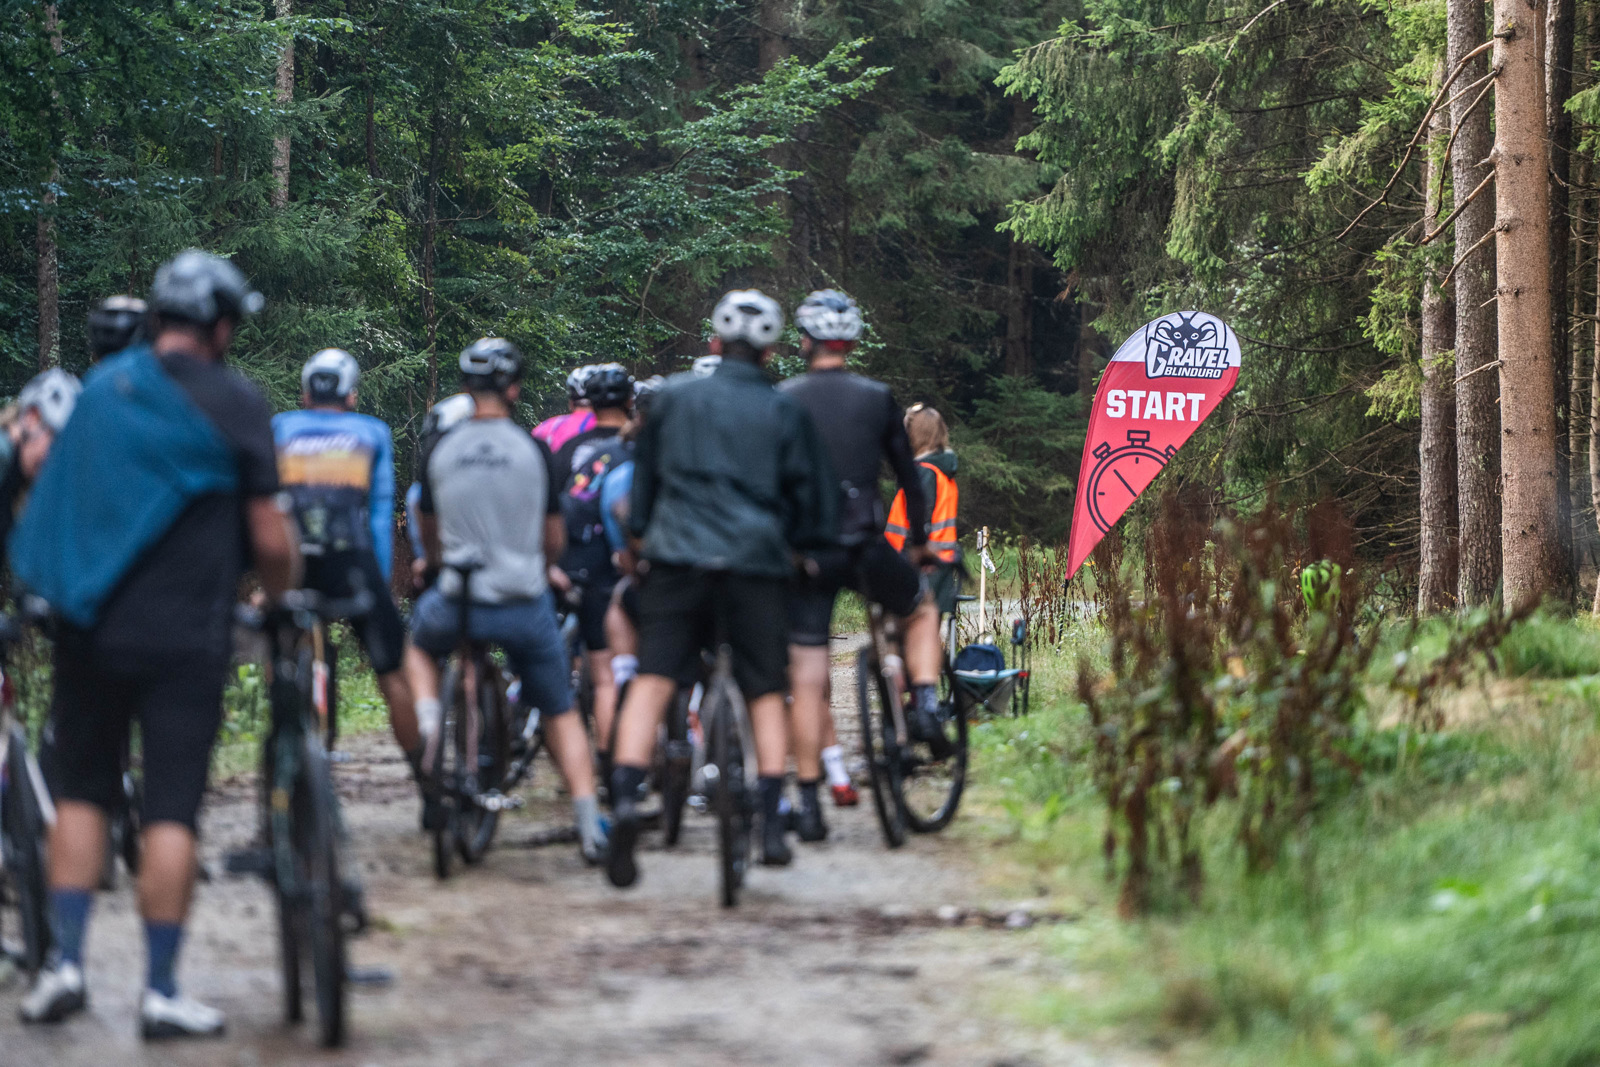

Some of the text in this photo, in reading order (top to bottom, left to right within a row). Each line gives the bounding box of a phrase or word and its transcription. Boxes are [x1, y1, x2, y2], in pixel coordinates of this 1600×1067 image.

[1146, 338, 1229, 377] GRAVEL
[1164, 367, 1222, 378] BLINDURO
[1106, 389, 1206, 422] START
